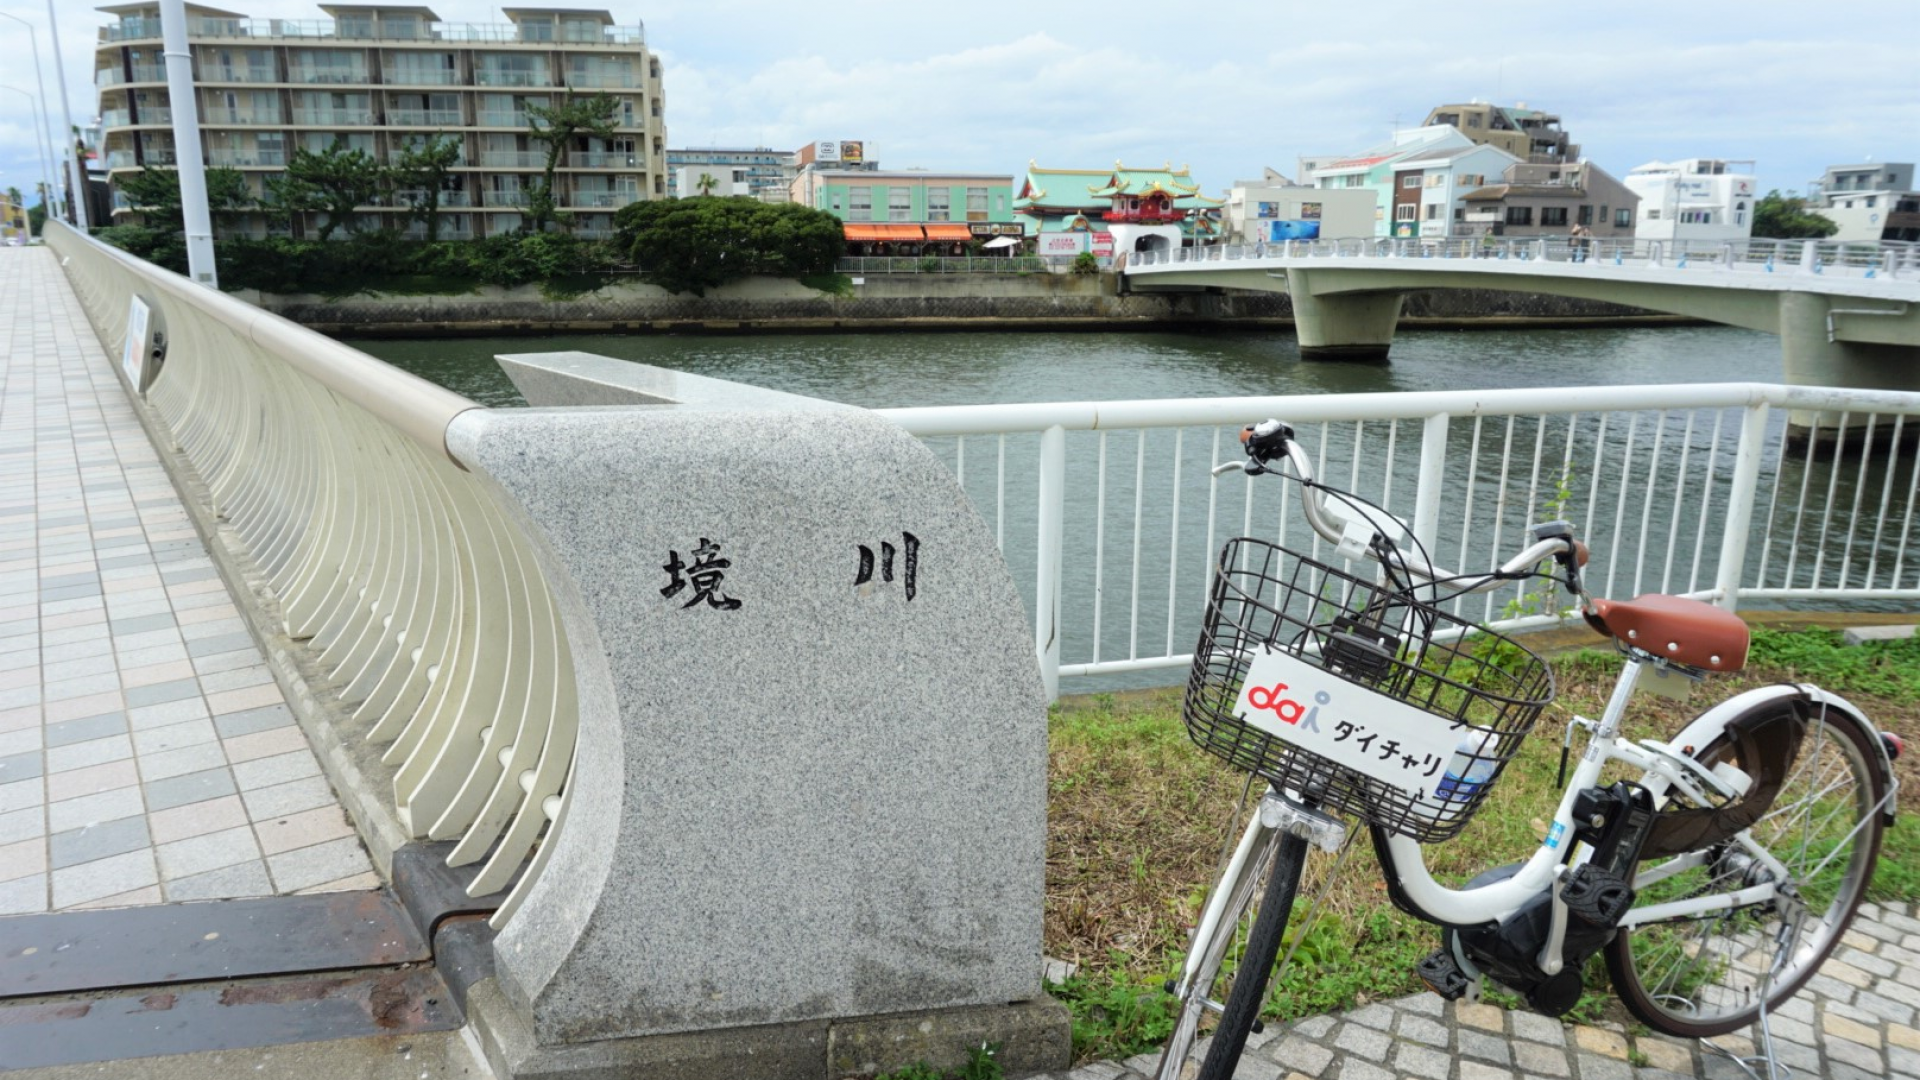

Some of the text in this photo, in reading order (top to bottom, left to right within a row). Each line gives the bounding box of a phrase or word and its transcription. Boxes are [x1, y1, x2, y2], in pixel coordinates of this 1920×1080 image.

[1248, 682, 1331, 733] dai
[1333, 720, 1442, 777] ダイチャリ
